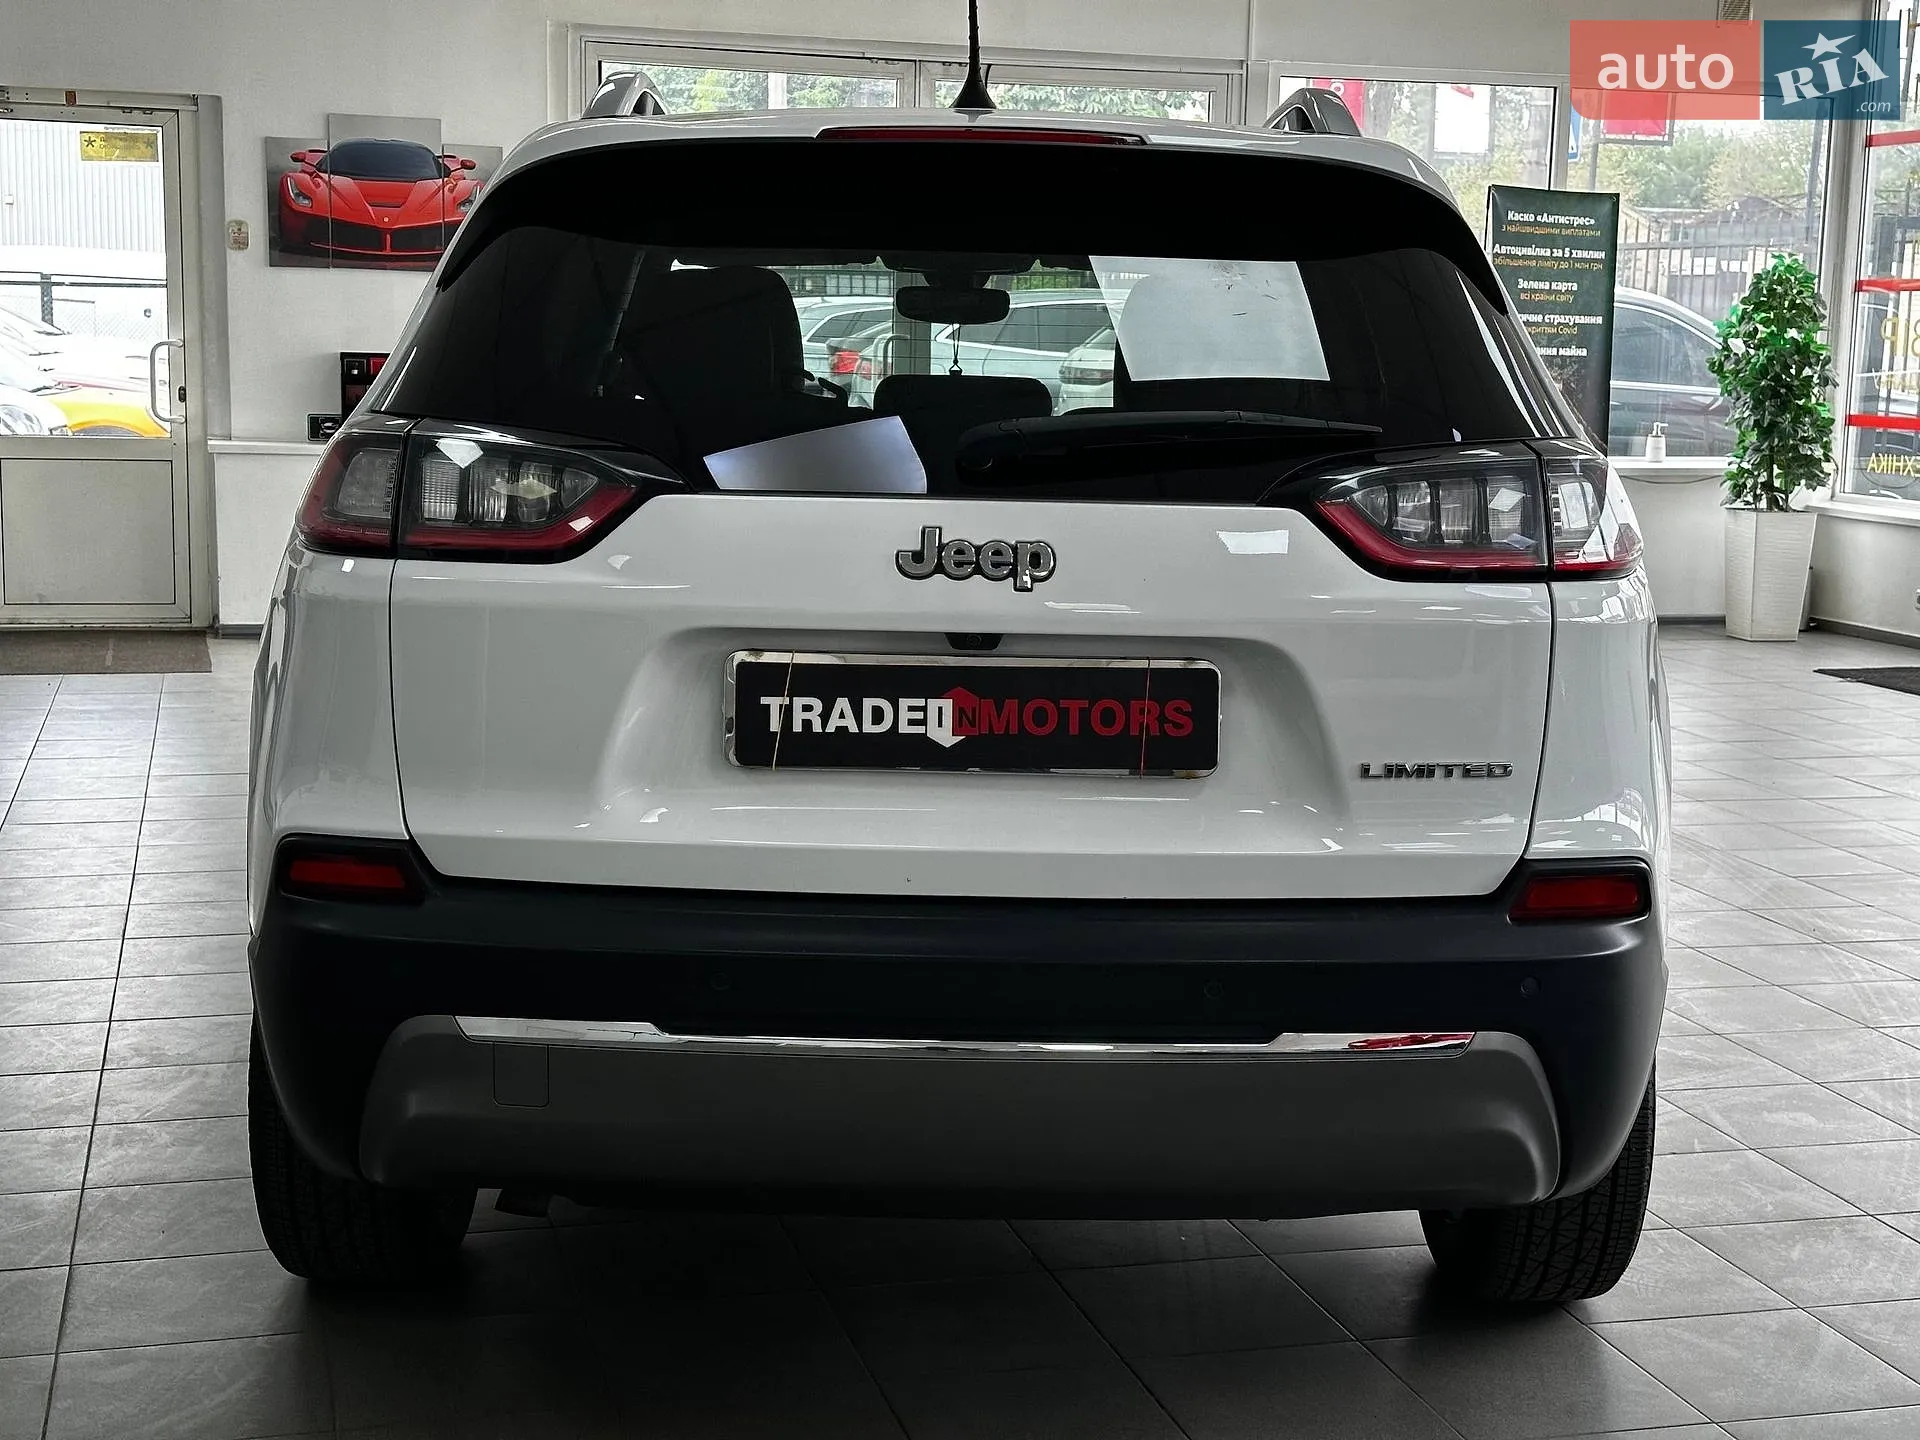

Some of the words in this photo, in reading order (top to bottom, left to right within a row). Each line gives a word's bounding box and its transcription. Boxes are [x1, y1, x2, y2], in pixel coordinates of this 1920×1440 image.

[1508, 210, 1535, 221] Каско
[1536, 212, 1596, 227] «Антистрес»
[1561, 228, 1601, 237] виплатами
[1493, 243, 1551, 257] Автоцивілка
[1552, 249, 1563, 258] за
[1564, 248, 1570, 258] 5
[1571, 250, 1606, 259] хвилин
[1559, 261, 1569, 269] до
[1590, 263, 1603, 272] грн
[1518, 278, 1549, 290] Зелена
[1551, 281, 1578, 292] карта
[1520, 291, 1531, 300] всі
[1532, 291, 1555, 302] країни
[1556, 293, 1575, 303] світу
[1544, 313, 1603, 325] страхування
[1558, 325, 1578, 335] Covid
[1559, 345, 1587, 356] майна
[895, 525, 1057, 592] Jeep
[1361, 762, 1513, 779] LIMITED
